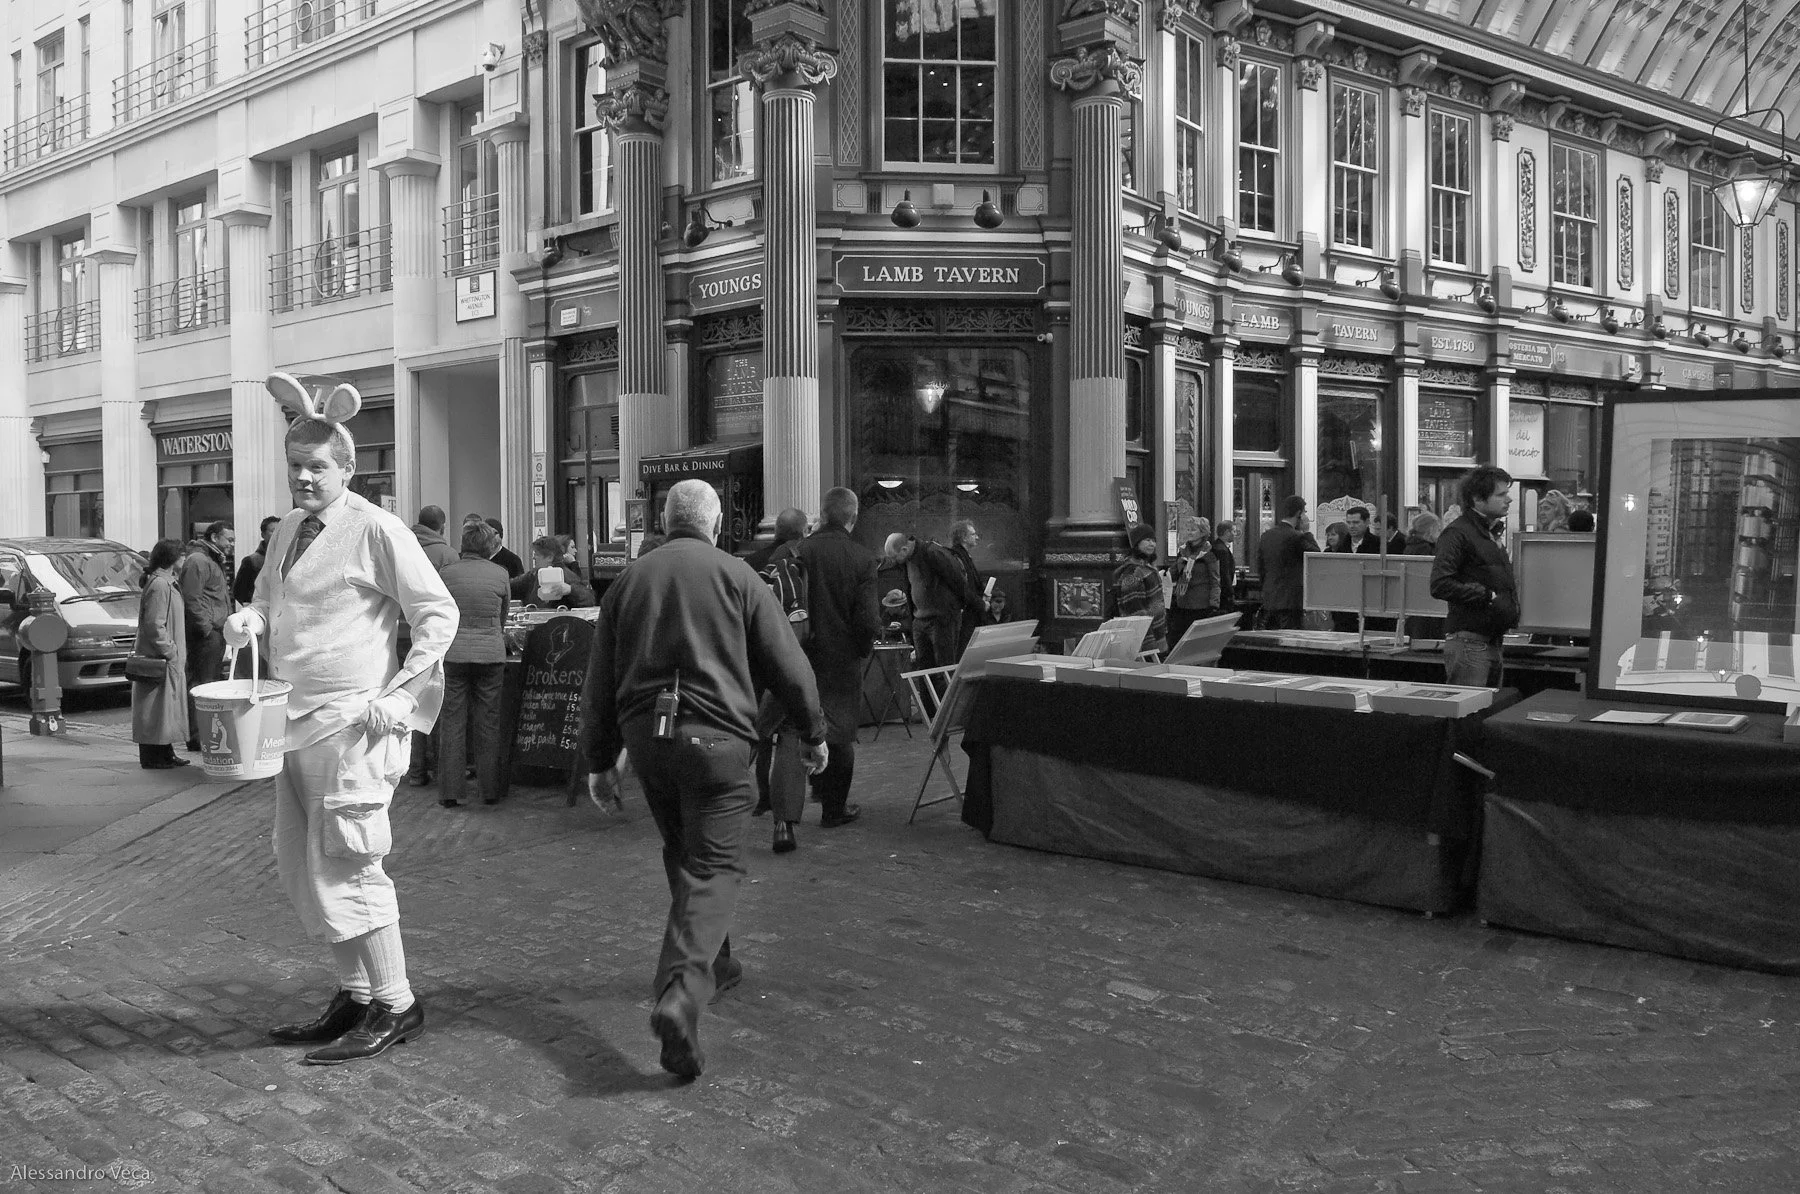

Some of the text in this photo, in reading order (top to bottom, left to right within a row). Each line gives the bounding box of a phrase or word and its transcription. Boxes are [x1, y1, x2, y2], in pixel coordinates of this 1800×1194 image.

[863, 266, 1019, 283] LAMB TAVERN
[699, 273, 762, 299] YOUNGS
[1240, 313, 1280, 330] LAMB
[1332, 323, 1378, 341] TAVERN
[1513, 352, 1543, 363] MERCATO
[643, 460, 725, 474] DIVE BAR & DINING
[526, 664, 583, 686] Brokers
